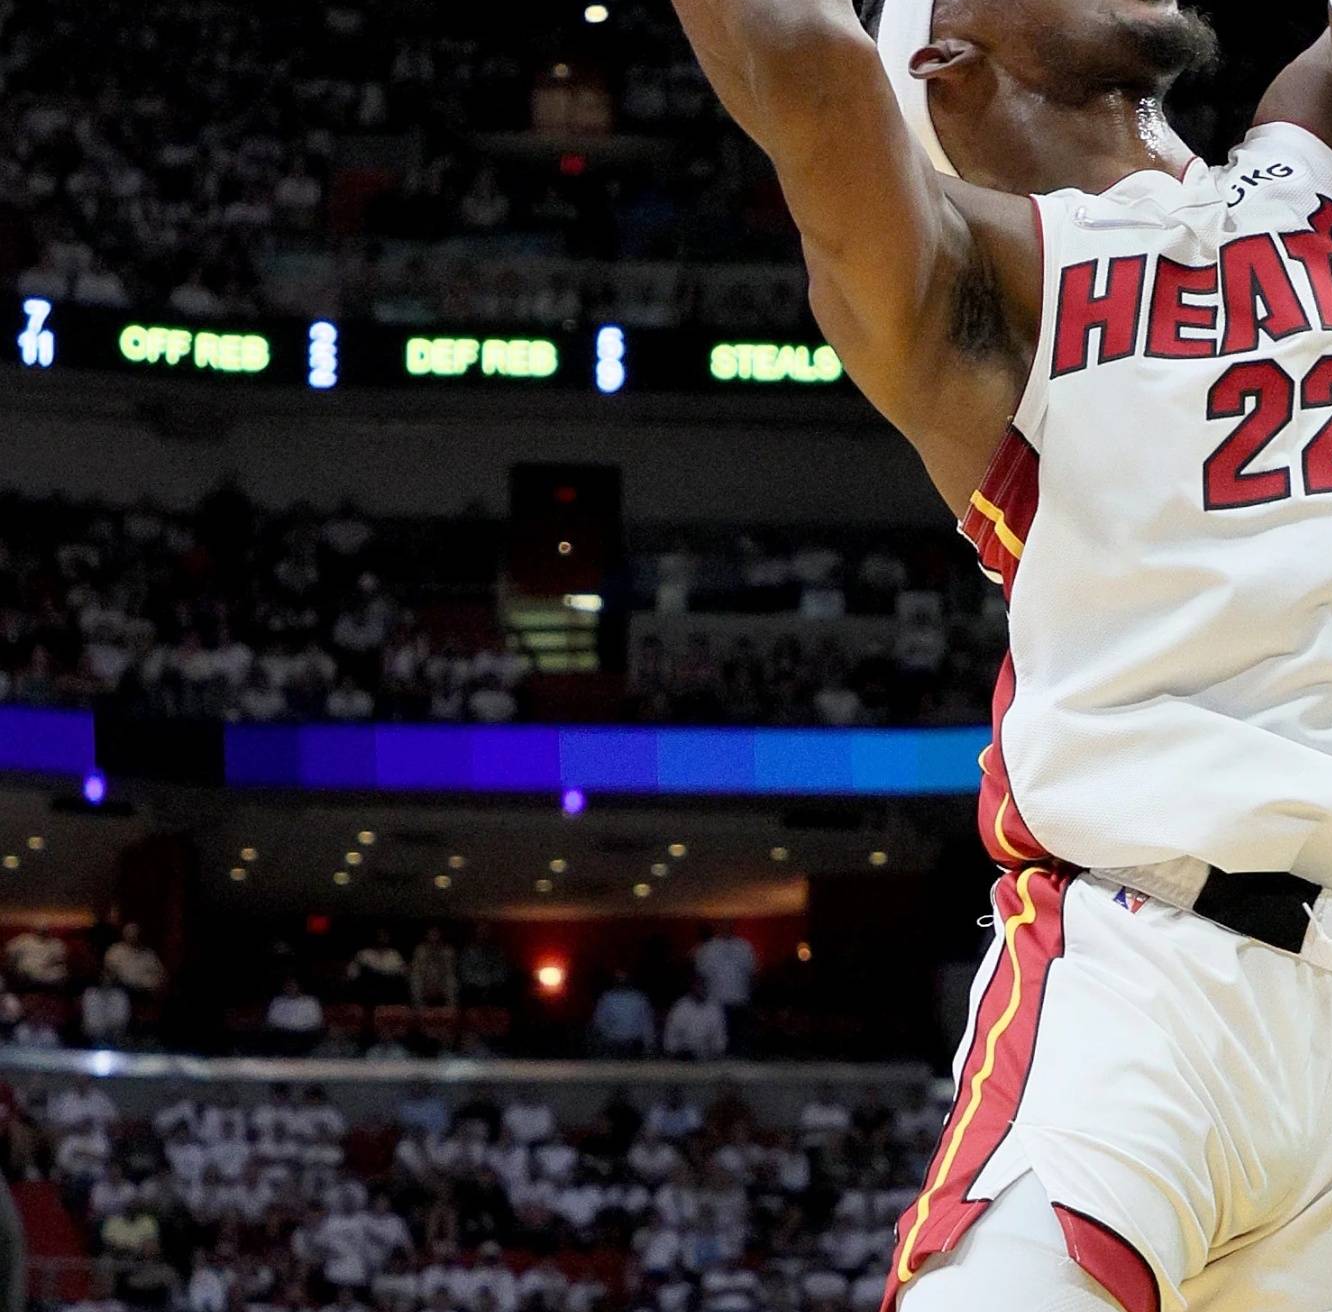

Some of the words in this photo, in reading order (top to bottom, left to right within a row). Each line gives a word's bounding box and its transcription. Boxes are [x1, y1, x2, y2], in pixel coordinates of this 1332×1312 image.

[118, 323, 193, 365] OFF
[405, 337, 481, 376] DEF
[709, 342, 843, 382] STEALS
